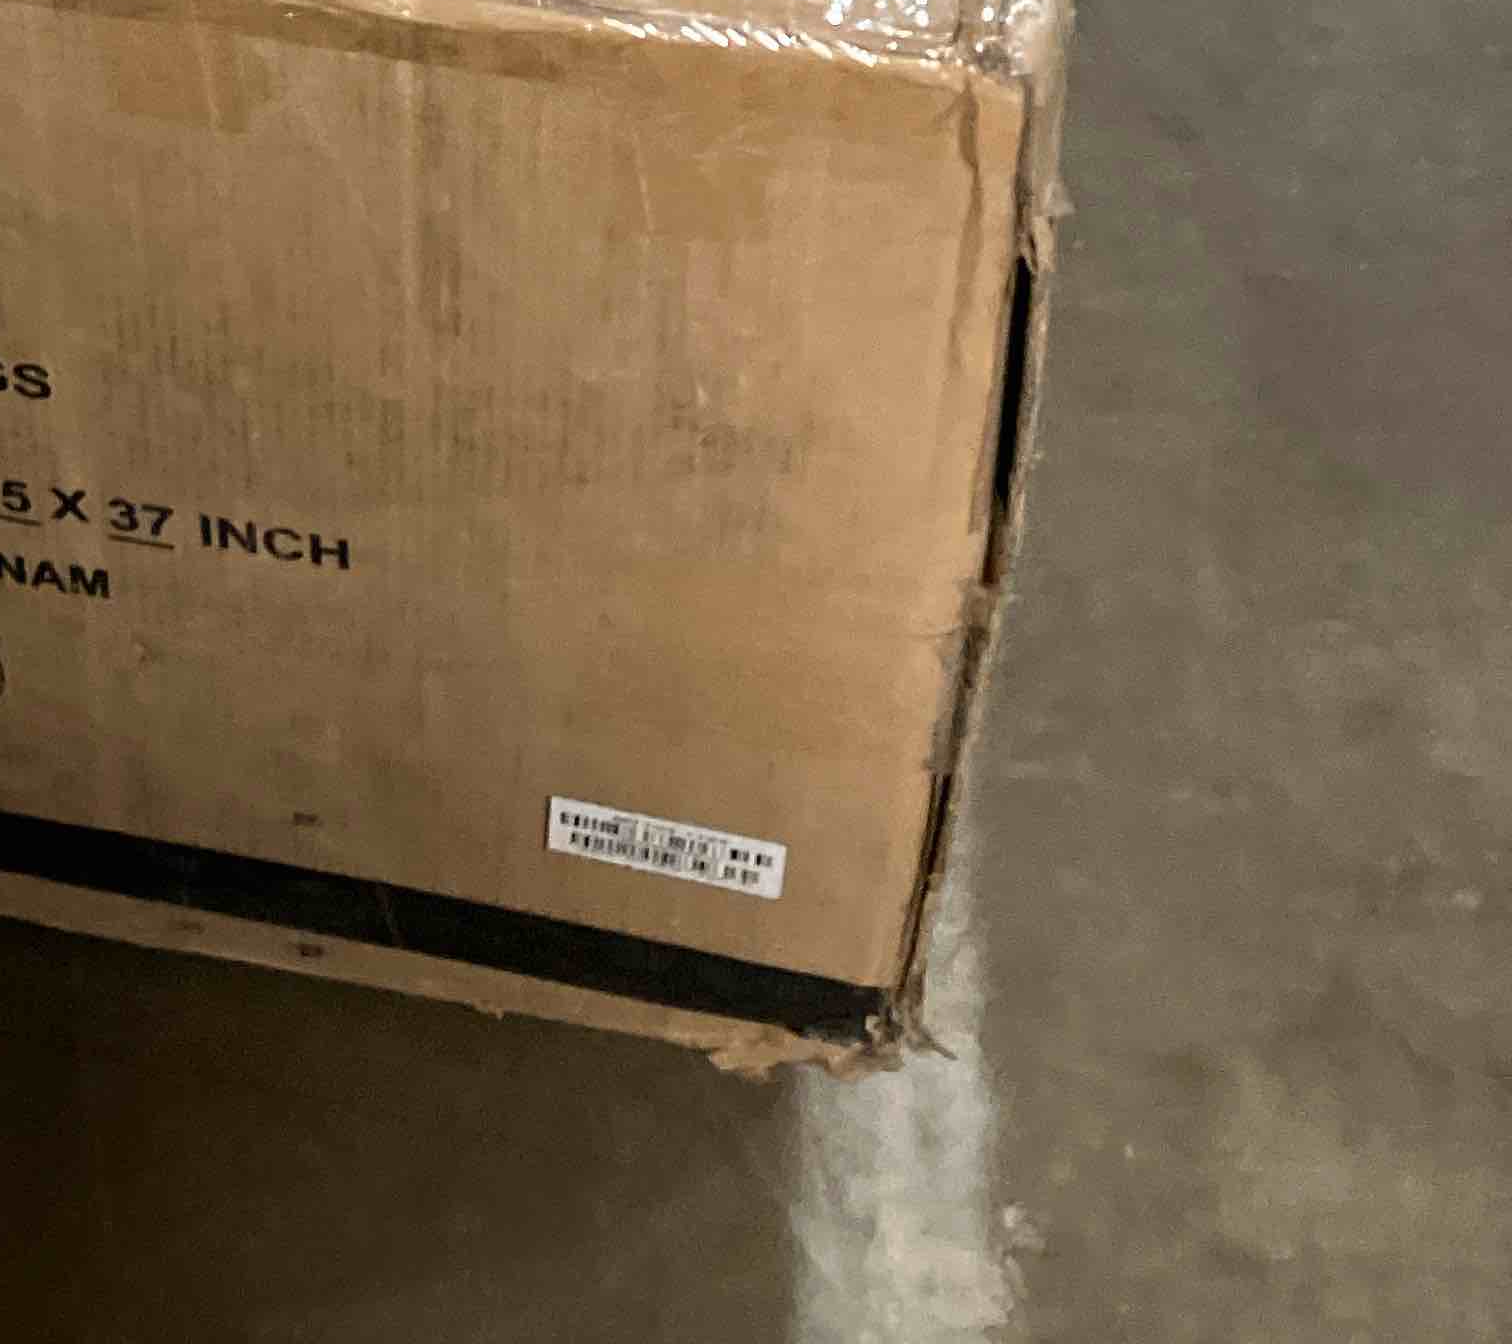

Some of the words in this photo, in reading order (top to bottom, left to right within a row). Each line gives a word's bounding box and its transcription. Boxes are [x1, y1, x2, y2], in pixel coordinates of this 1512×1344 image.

[50, 486, 90, 524] X
[108, 497, 176, 539] 37
[199, 513, 352, 571] INCH
